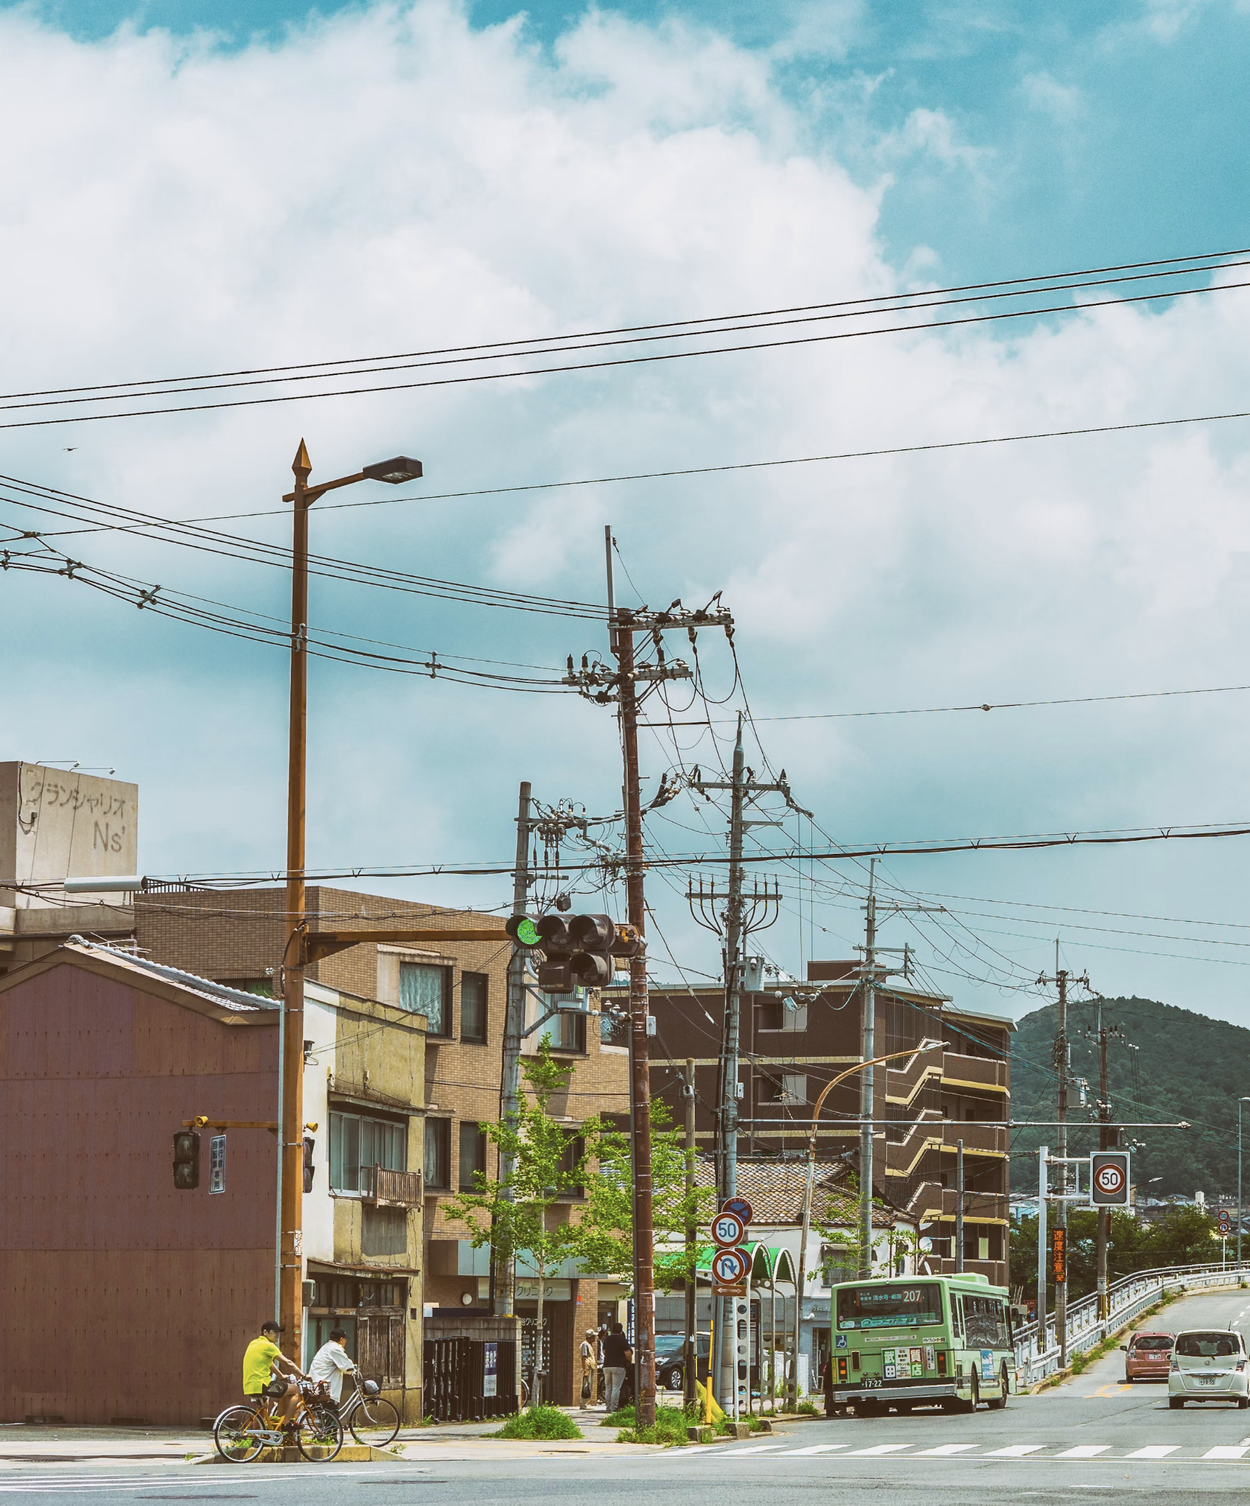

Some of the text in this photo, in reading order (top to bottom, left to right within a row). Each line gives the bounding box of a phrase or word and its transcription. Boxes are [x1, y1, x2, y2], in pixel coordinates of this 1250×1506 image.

[1101, 1172, 1119, 1186] 50
[718, 1222, 737, 1238] 50
[903, 1290, 921, 1303] 207
